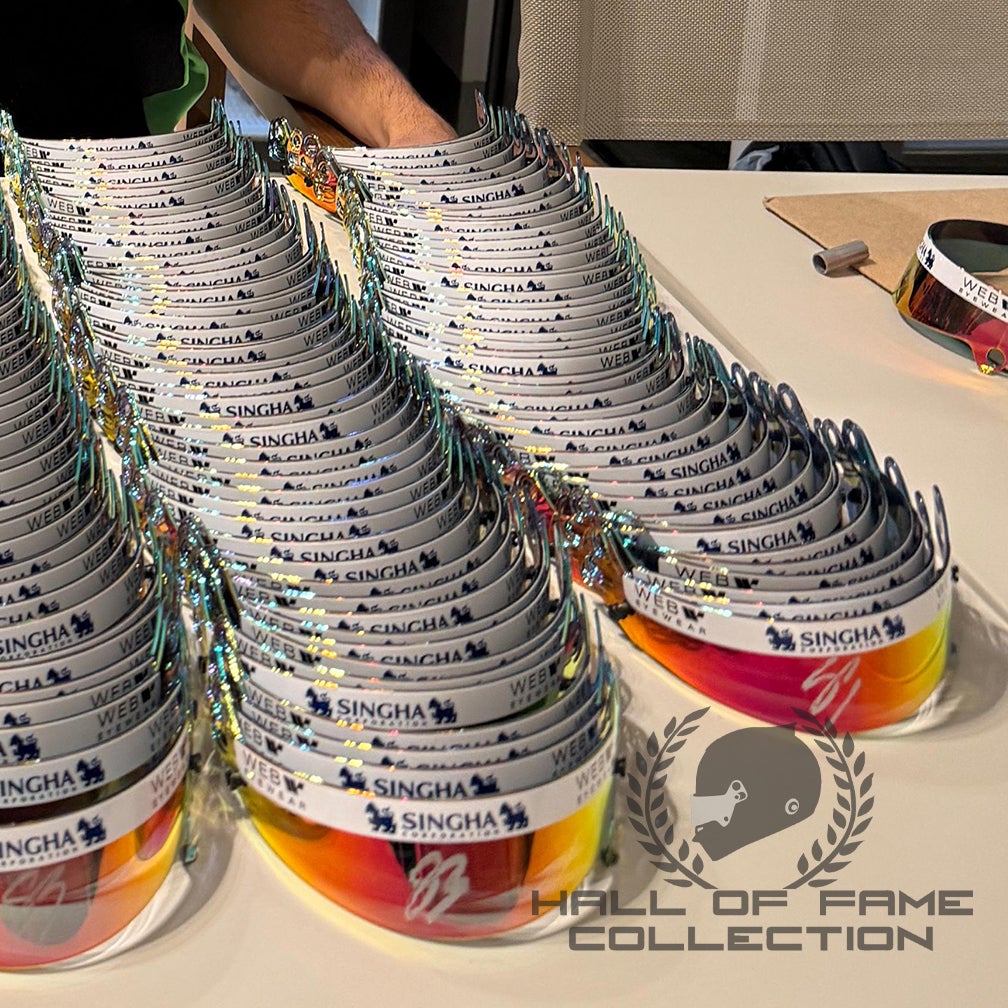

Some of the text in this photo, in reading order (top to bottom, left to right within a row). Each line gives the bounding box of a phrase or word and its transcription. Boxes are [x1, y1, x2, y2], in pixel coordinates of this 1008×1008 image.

[206, 158, 226, 172] WEB
[215, 178, 236, 193] WEB
[48, 200, 74, 212] WEB
[462, 191, 511, 203] SINGHA
[560, 206, 581, 222] WEB
[586, 247, 608, 263] WEB
[287, 268, 307, 286] WEB
[464, 282, 524, 293] SINGHA
[963, 276, 999, 306] WEB
[298, 309, 321, 327] WEB
[304, 327, 328, 346] WEB
[0, 354, 25, 376] WEB
[601, 352, 630, 368] WEB
[346, 367, 369, 389] WEB
[226, 399, 292, 416] SINGHA
[372, 392, 391, 416] WEB
[22, 419, 51, 444] WEB
[250, 431, 319, 448] SINGHA
[40, 447, 68, 472] WEB
[671, 457, 728, 479] SINGHA
[410, 477, 435, 500] WEB
[414, 493, 440, 519] WEB
[741, 497, 797, 521] SINGHA
[27, 505, 62, 531] WEB
[57, 512, 83, 538] WEB
[728, 530, 797, 554] SINGHA
[301, 548, 374, 562] SINGHA
[346, 564, 419, 582] SINGHA
[676, 566, 729, 587] WEB
[635, 584, 678, 615] WEB
[371, 616, 448, 633] SINGHA
[119, 624, 153, 654] WEB
[252, 627, 295, 659] WEB
[800, 628, 879, 648] SINGHA
[381, 649, 463, 664] SINGHA
[510, 669, 546, 695] WEB
[97, 696, 138, 727] WEB
[251, 687, 287, 720] WEB
[336, 698, 426, 719] SINGHA
[552, 733, 587, 765] WEB
[243, 750, 280, 786] WEB
[373, 777, 465, 799] SINGHA
[401, 810, 498, 831] SINGHA
